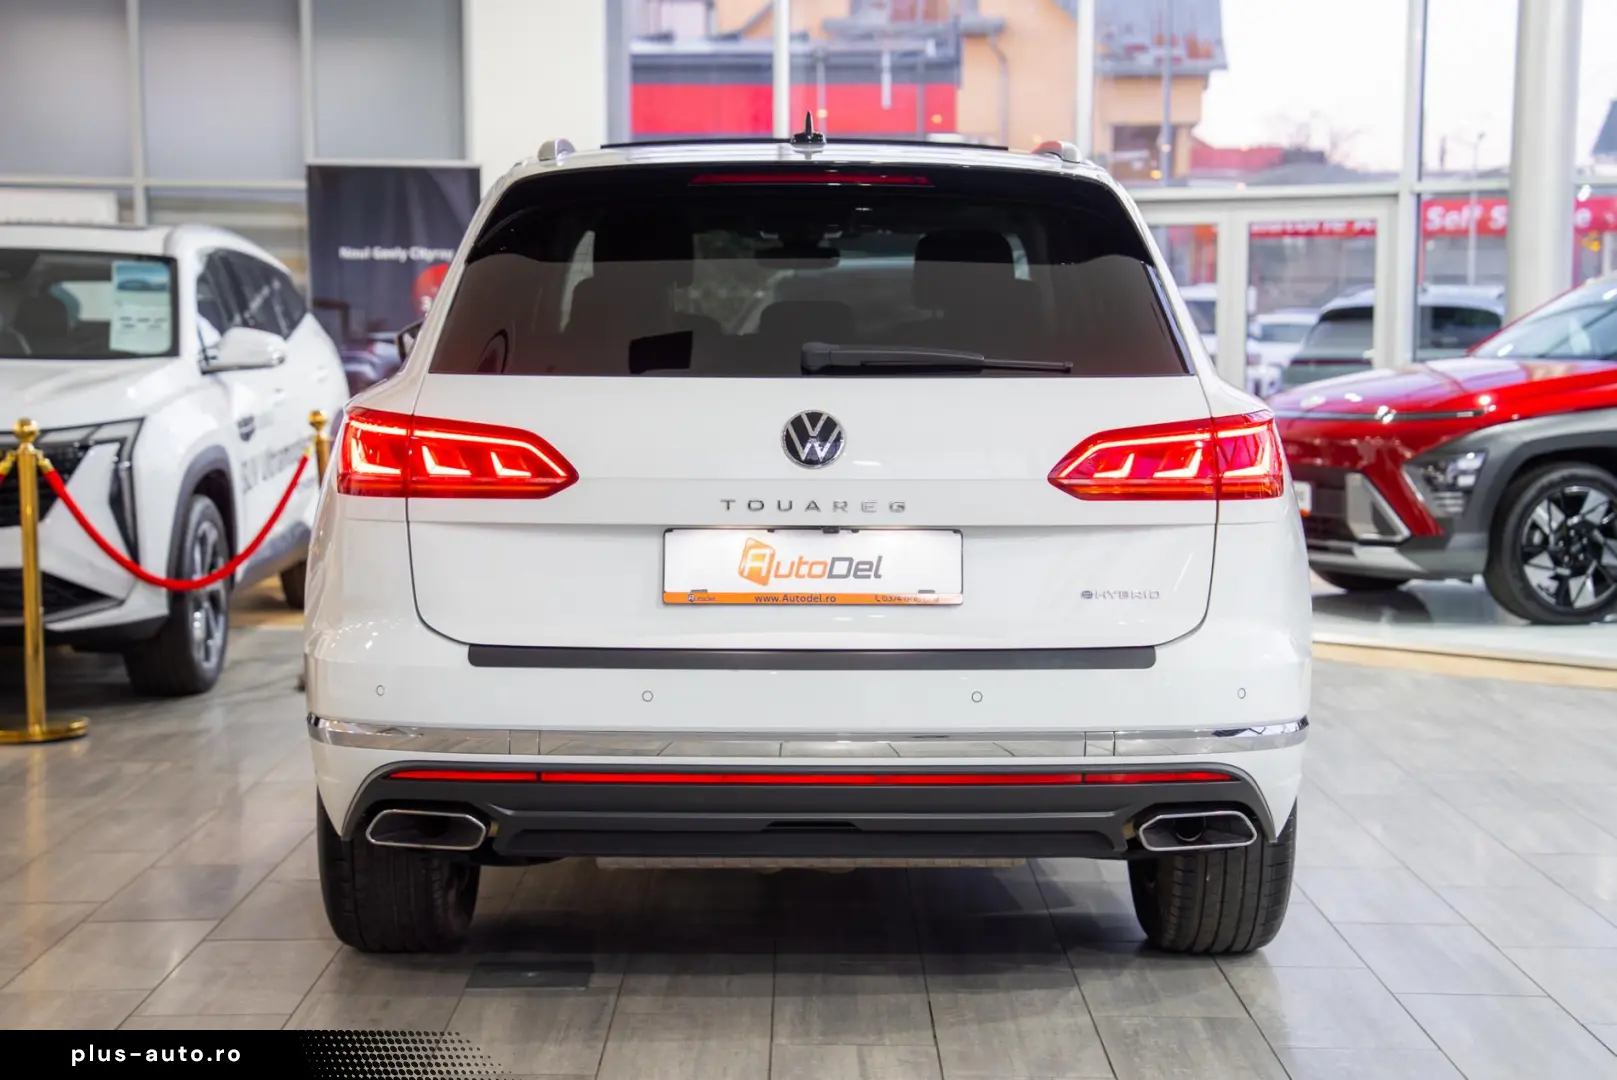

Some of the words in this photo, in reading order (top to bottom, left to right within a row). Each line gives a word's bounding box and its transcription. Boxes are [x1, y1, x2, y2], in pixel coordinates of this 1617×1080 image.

[720, 499, 907, 513] TOUAREG
[738, 538, 883, 585] AutoDel
[754, 593, 837, 604] www.Autodel.ro
